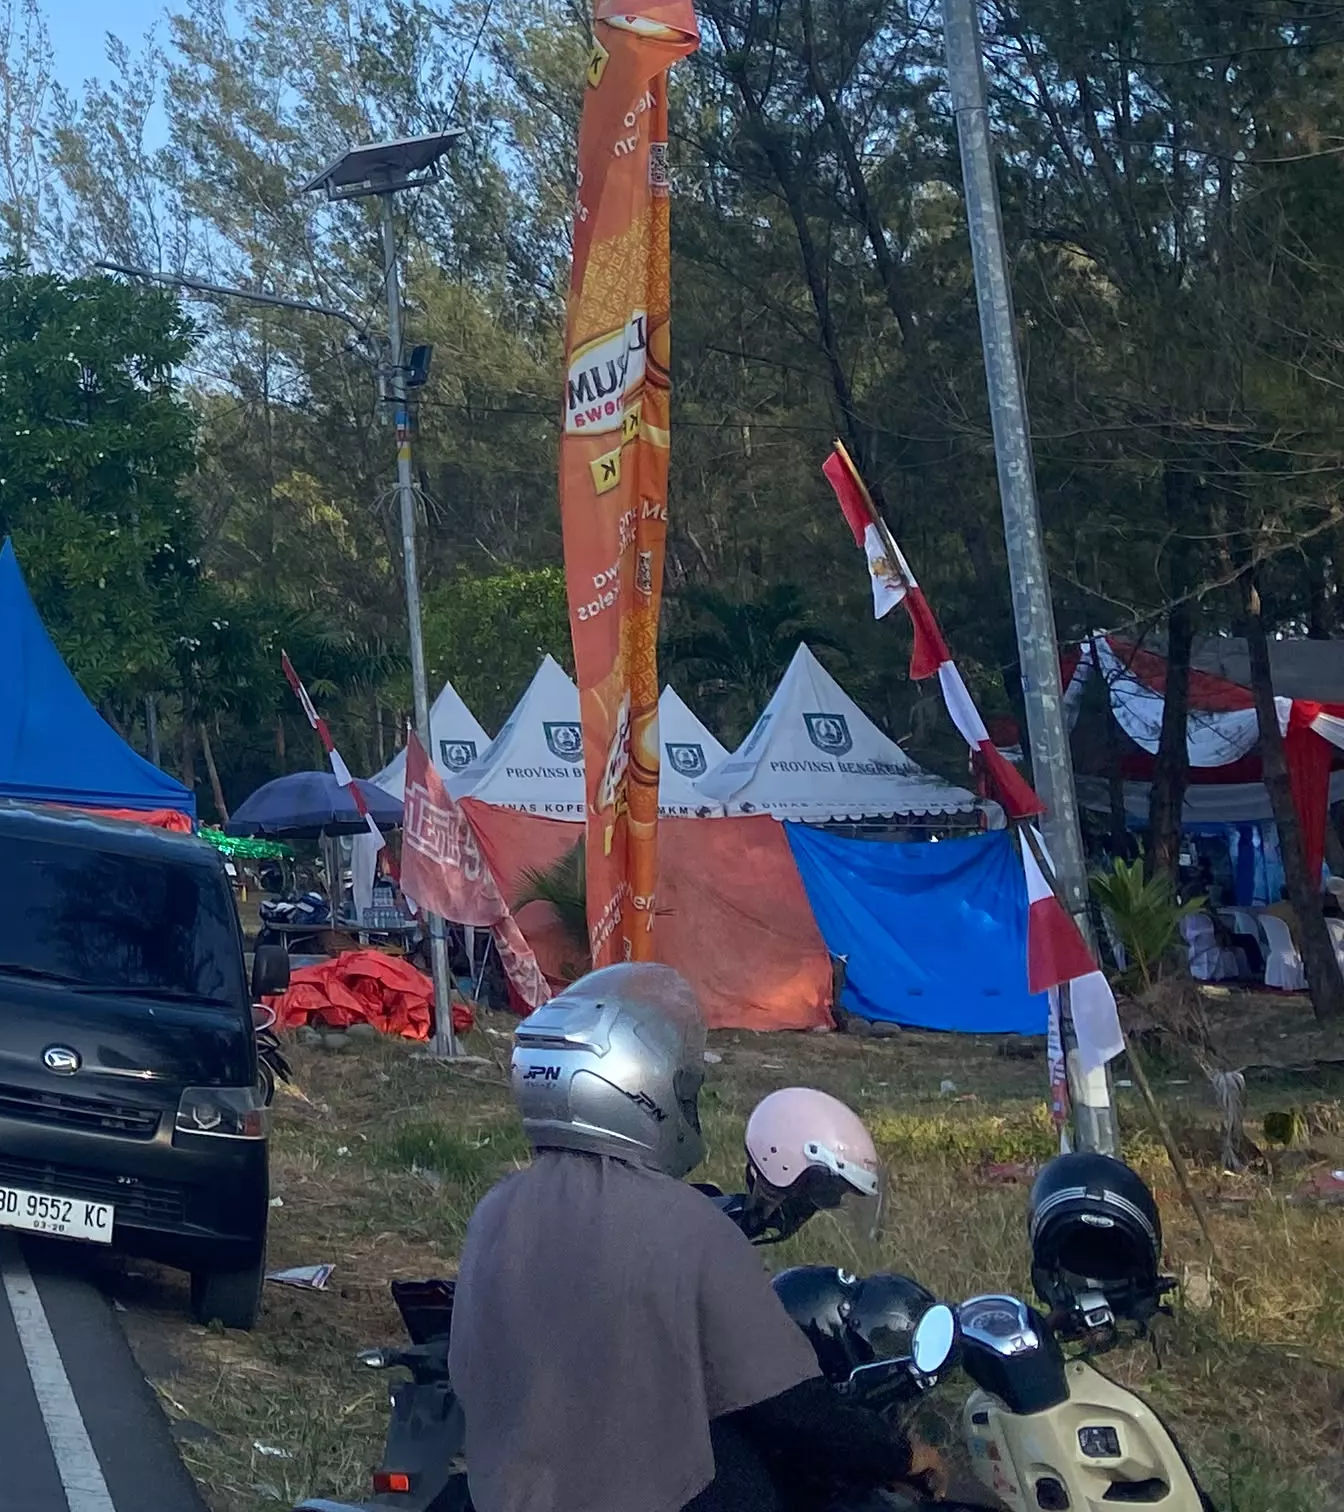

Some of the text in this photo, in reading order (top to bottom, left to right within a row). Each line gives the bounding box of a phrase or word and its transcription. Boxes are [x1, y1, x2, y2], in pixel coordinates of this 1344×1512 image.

[770, 760, 836, 773] PROVINSI
[506, 767, 569, 779] PROVINSI
[544, 804, 584, 813] KOPE
[657, 806, 688, 814] MKM
[26, 1195, 73, 1223] 9552
[84, 1204, 109, 1229] KC
